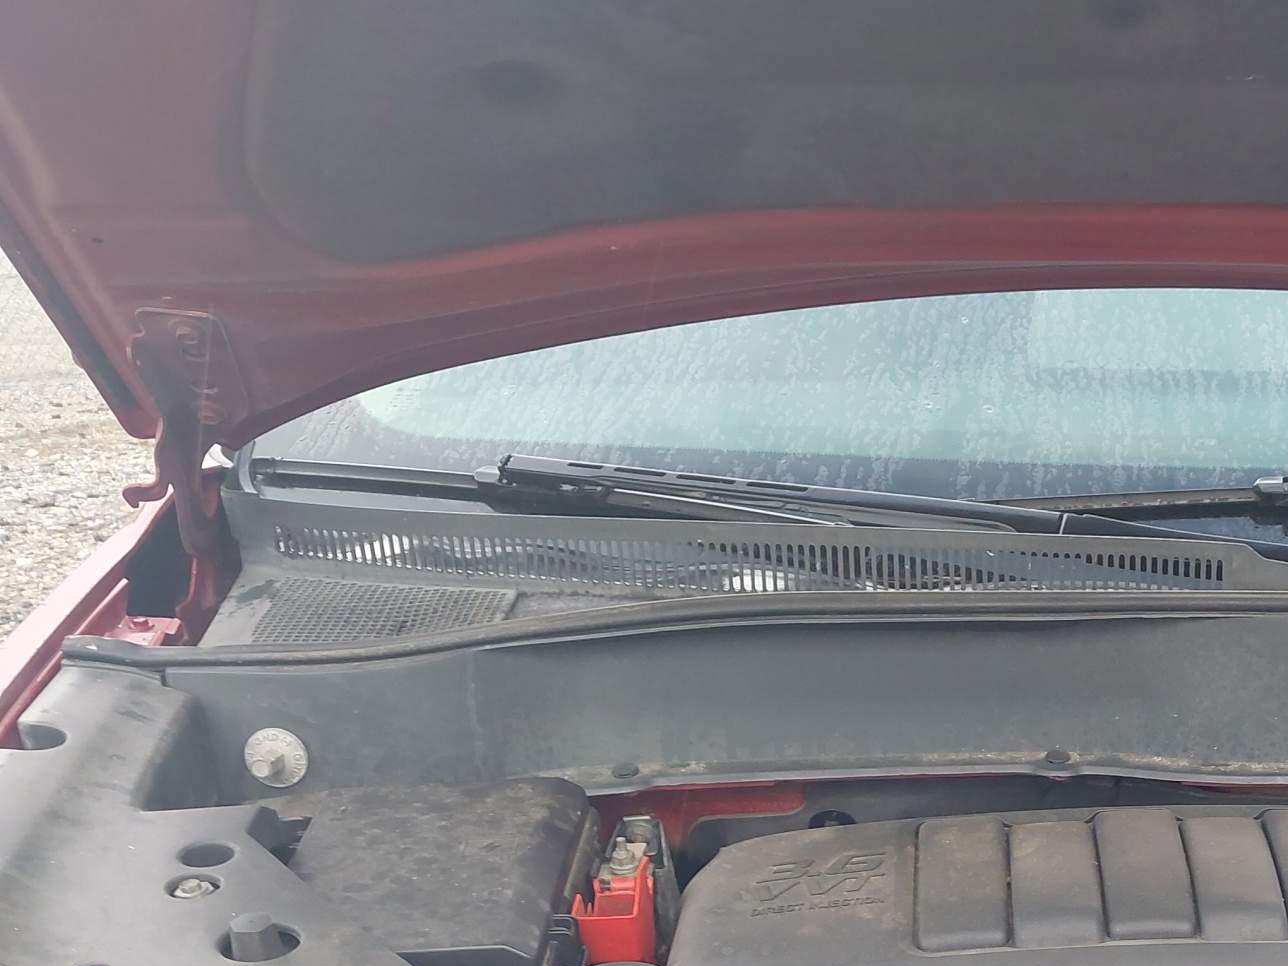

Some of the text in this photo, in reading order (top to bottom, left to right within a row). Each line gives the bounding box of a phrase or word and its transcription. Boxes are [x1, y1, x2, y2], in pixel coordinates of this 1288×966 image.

[755, 850, 887, 885] 3.6
[752, 872, 887, 903] VVT
[751, 897, 886, 918] DIRECT INJECTION
